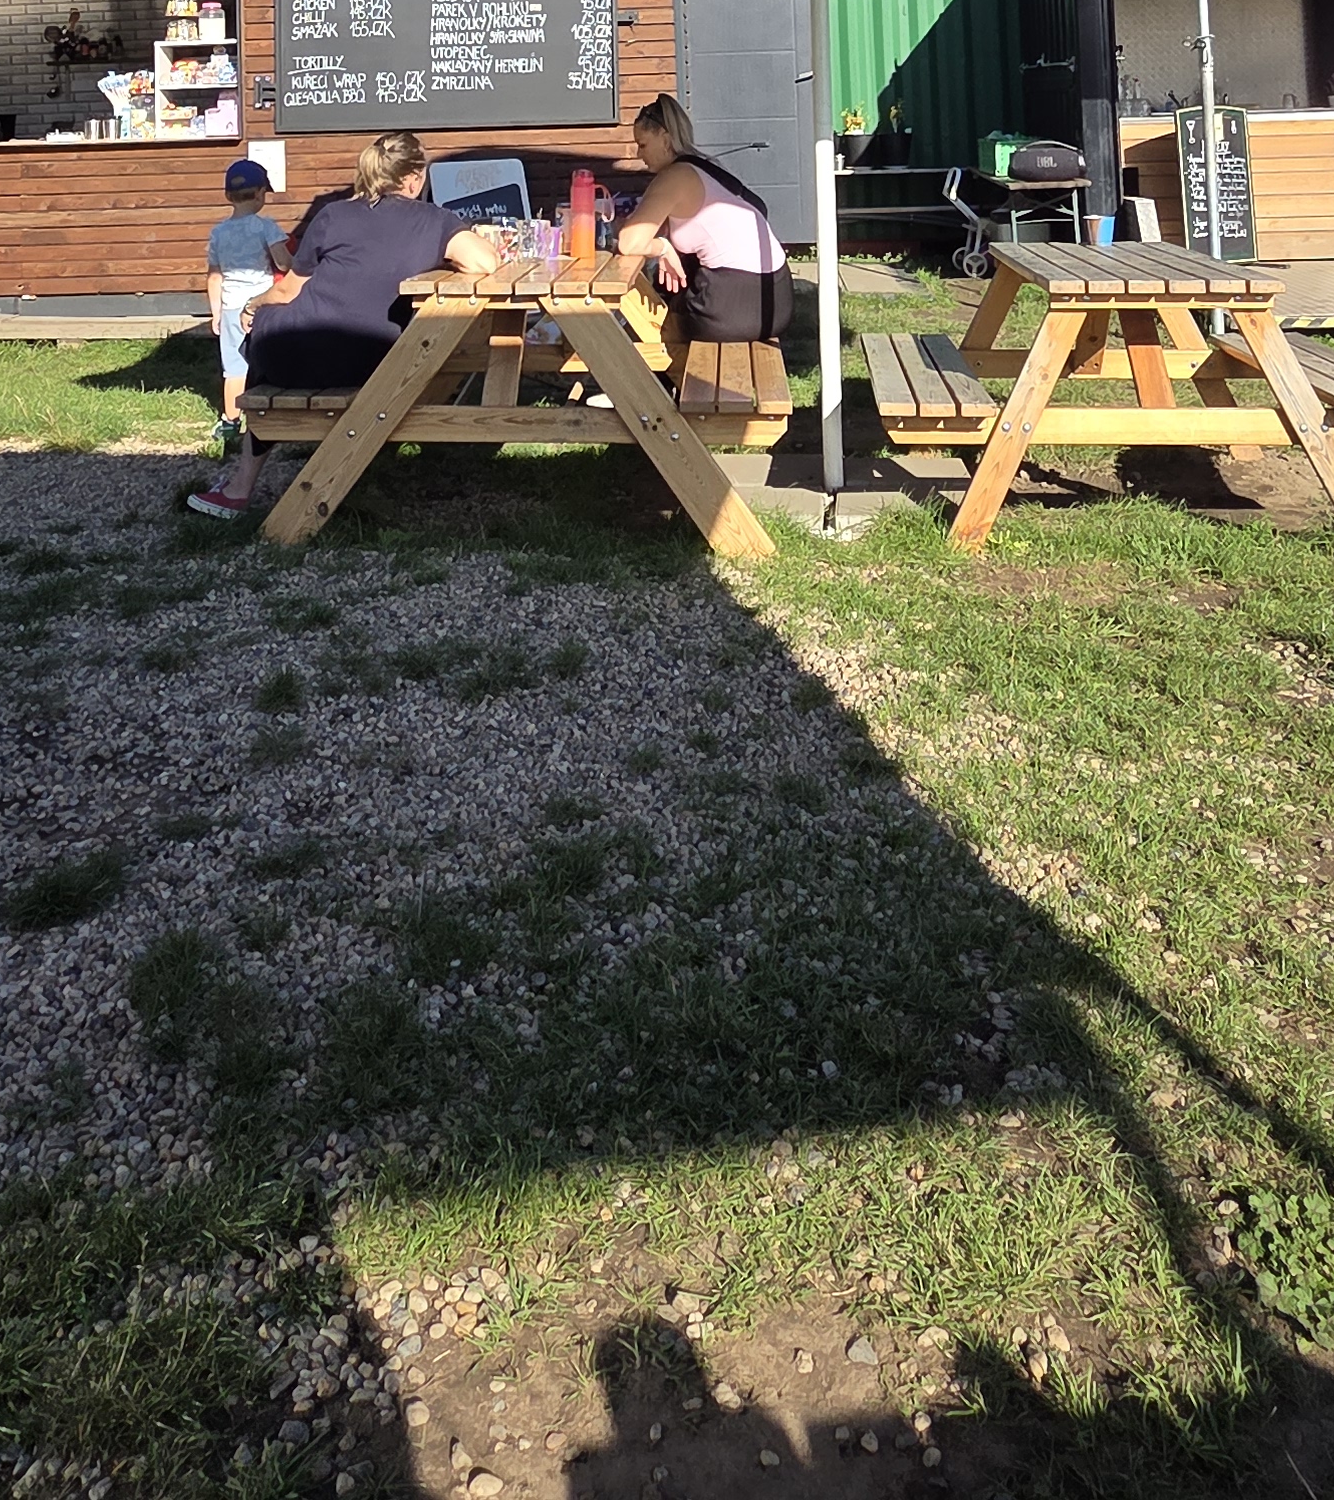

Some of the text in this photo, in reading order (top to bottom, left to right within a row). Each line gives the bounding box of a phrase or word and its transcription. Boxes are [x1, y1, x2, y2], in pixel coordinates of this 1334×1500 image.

[469, 2, 479, 17] V
[430, 30, 486, 45] HRANOLKY
[292, 55, 345, 69] TORTILLY
[334, 72, 367, 88] WRAP
[431, 74, 495, 90] ZMRZLINA
[342, 88, 366, 104] BBQ
